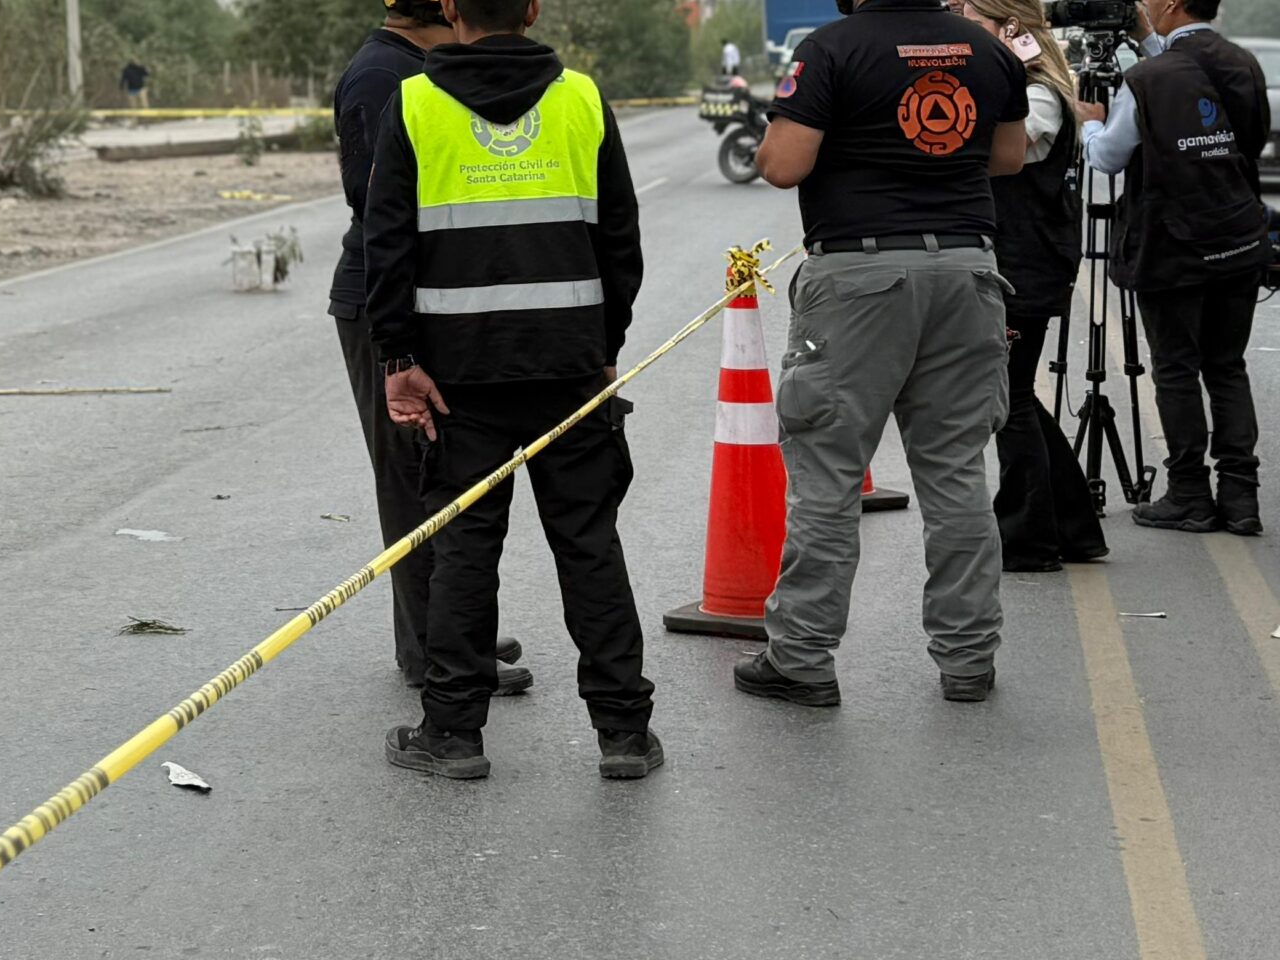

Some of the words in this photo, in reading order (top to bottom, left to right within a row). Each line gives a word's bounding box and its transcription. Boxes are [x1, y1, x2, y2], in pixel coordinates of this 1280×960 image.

[459, 161, 516, 174] Protección
[519, 159, 543, 170] Civil
[546, 158, 560, 168] de
[466, 174, 496, 185] Santa
[499, 171, 546, 182] Catarina
